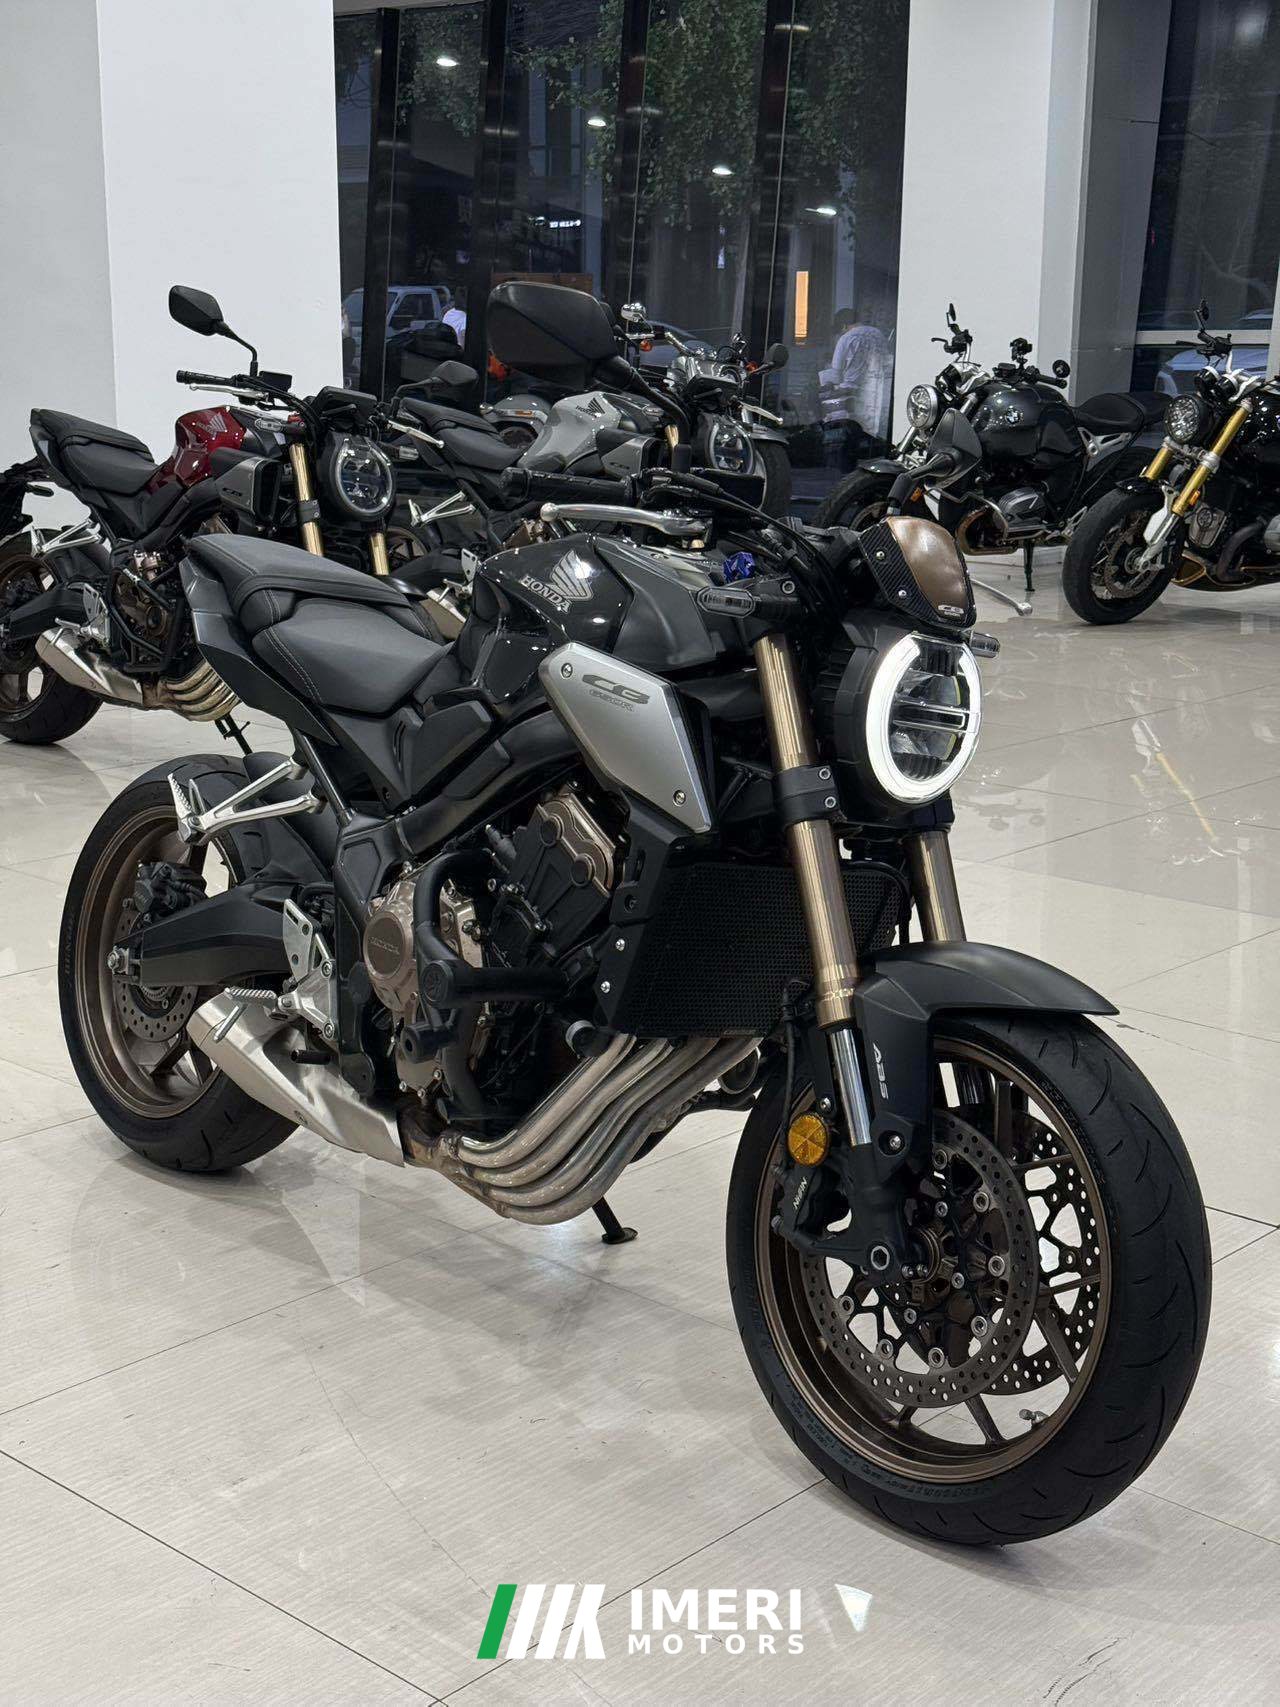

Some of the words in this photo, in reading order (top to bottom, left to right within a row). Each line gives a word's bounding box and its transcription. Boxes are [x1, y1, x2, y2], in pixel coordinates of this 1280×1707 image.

[519, 575, 573, 614] HONDA
[582, 674, 651, 705] CB
[873, 1043, 889, 1100] ABS
